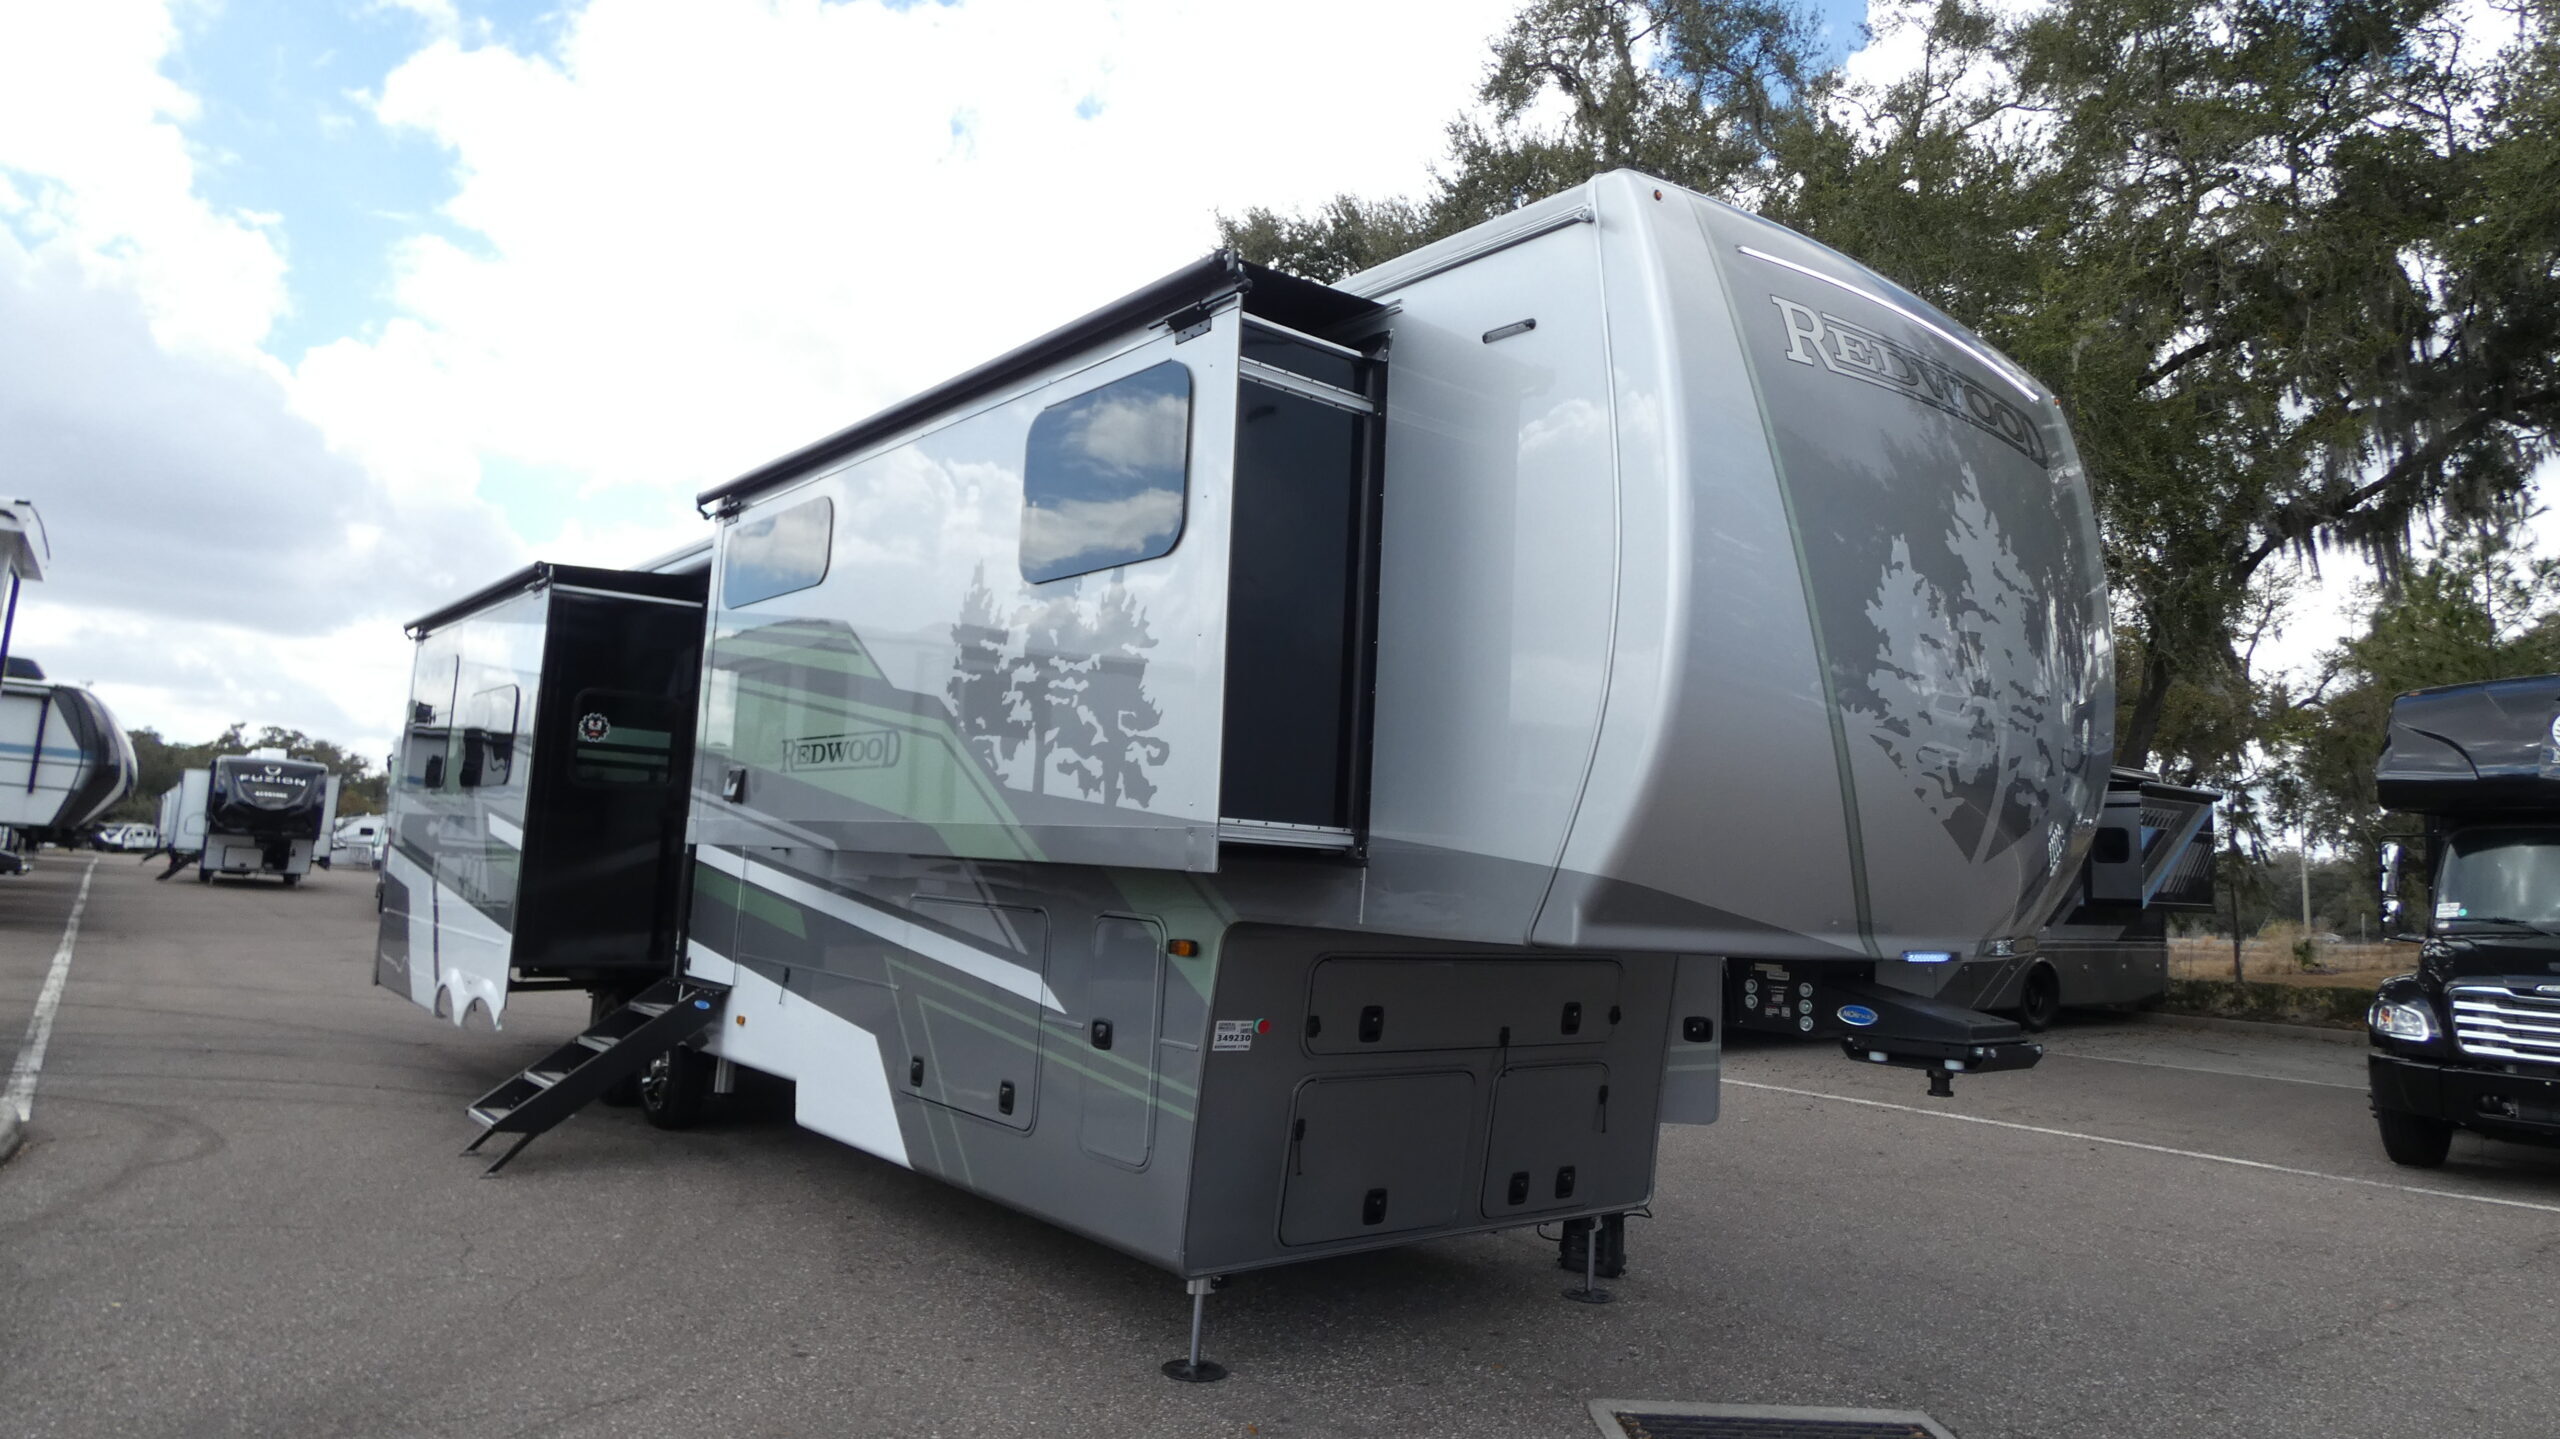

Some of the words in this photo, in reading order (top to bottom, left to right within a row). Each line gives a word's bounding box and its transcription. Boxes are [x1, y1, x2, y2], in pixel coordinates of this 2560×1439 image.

[1769, 294, 2050, 470] REDWOOD
[779, 729, 902, 773] REDWOOD
[1217, 1034, 1251, 1042] 349230
